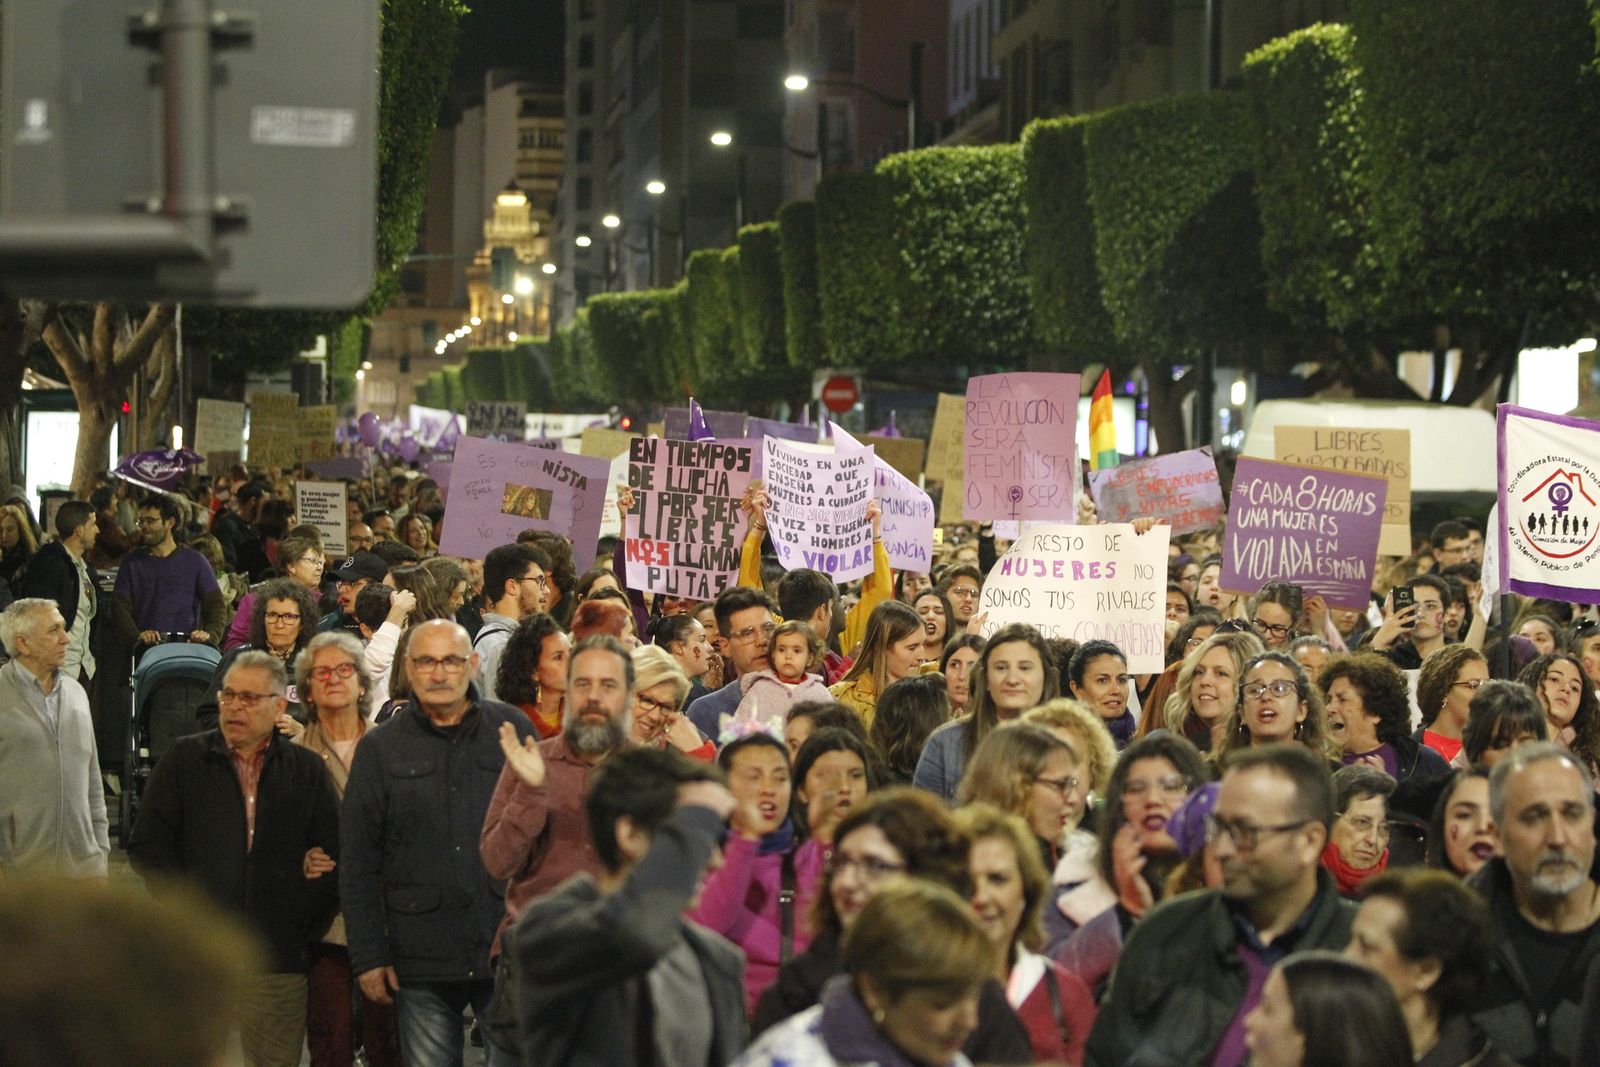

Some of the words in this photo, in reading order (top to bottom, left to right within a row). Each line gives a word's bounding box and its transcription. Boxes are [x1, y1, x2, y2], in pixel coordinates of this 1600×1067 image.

[979, 375, 1015, 399] LA
[629, 437, 658, 464] EN
[666, 440, 752, 472] TIEMPOS
[767, 440, 809, 468] VIVIMOS
[817, 460, 832, 470] EN
[840, 456, 865, 469] UNA
[628, 463, 655, 491] DE
[665, 466, 730, 497] LUCHA
[768, 470, 815, 494] ENSEÑA
[825, 485, 834, 496] A
[846, 477, 870, 494] LAS
[769, 458, 812, 481] SOCIEDAD
[834, 469, 859, 482] QUE
[1507, 458, 1547, 494] Coordinadora
[1547, 455, 1571, 464] Estatal
[1571, 461, 1584, 469] por
[1583, 466, 1590, 475] la
[657, 491, 698, 519] POR
[701, 494, 743, 524] SER
[768, 483, 812, 506] MUJERES
[817, 497, 826, 508] A
[828, 490, 867, 508] CUIDARSE
[1237, 478, 1294, 508] #CADA
[1296, 475, 1318, 511] 8
[1317, 484, 1377, 516] HORAS
[782, 517, 806, 532] VEZ
[815, 522, 831, 535] DE
[882, 522, 898, 533] LA
[1237, 507, 1269, 529] UNA
[638, 516, 736, 549] LIBRES
[778, 528, 800, 544] LOS
[810, 530, 862, 550] HOMBRES
[864, 527, 873, 540] A
[1032, 534, 1085, 553] RESTO
[1104, 534, 1122, 552] DE
[1532, 534, 1559, 543] Comisión
[673, 542, 741, 572] LLAMAN
[802, 544, 873, 573] VIOLAR
[1233, 532, 1314, 580] VIOLADA
[1315, 538, 1338, 554] EN
[1513, 538, 1539, 564] Sistema
[1573, 561, 1584, 569] de
[1000, 557, 1117, 581] MUJERES
[1133, 563, 1155, 581] NO
[1316, 555, 1366, 581] ESPAÑA
[647, 566, 728, 599] PUTAS
[985, 587, 1031, 609] SOMOS
[1044, 591, 1076, 610] TUS
[1096, 590, 1157, 613] RIVALES
